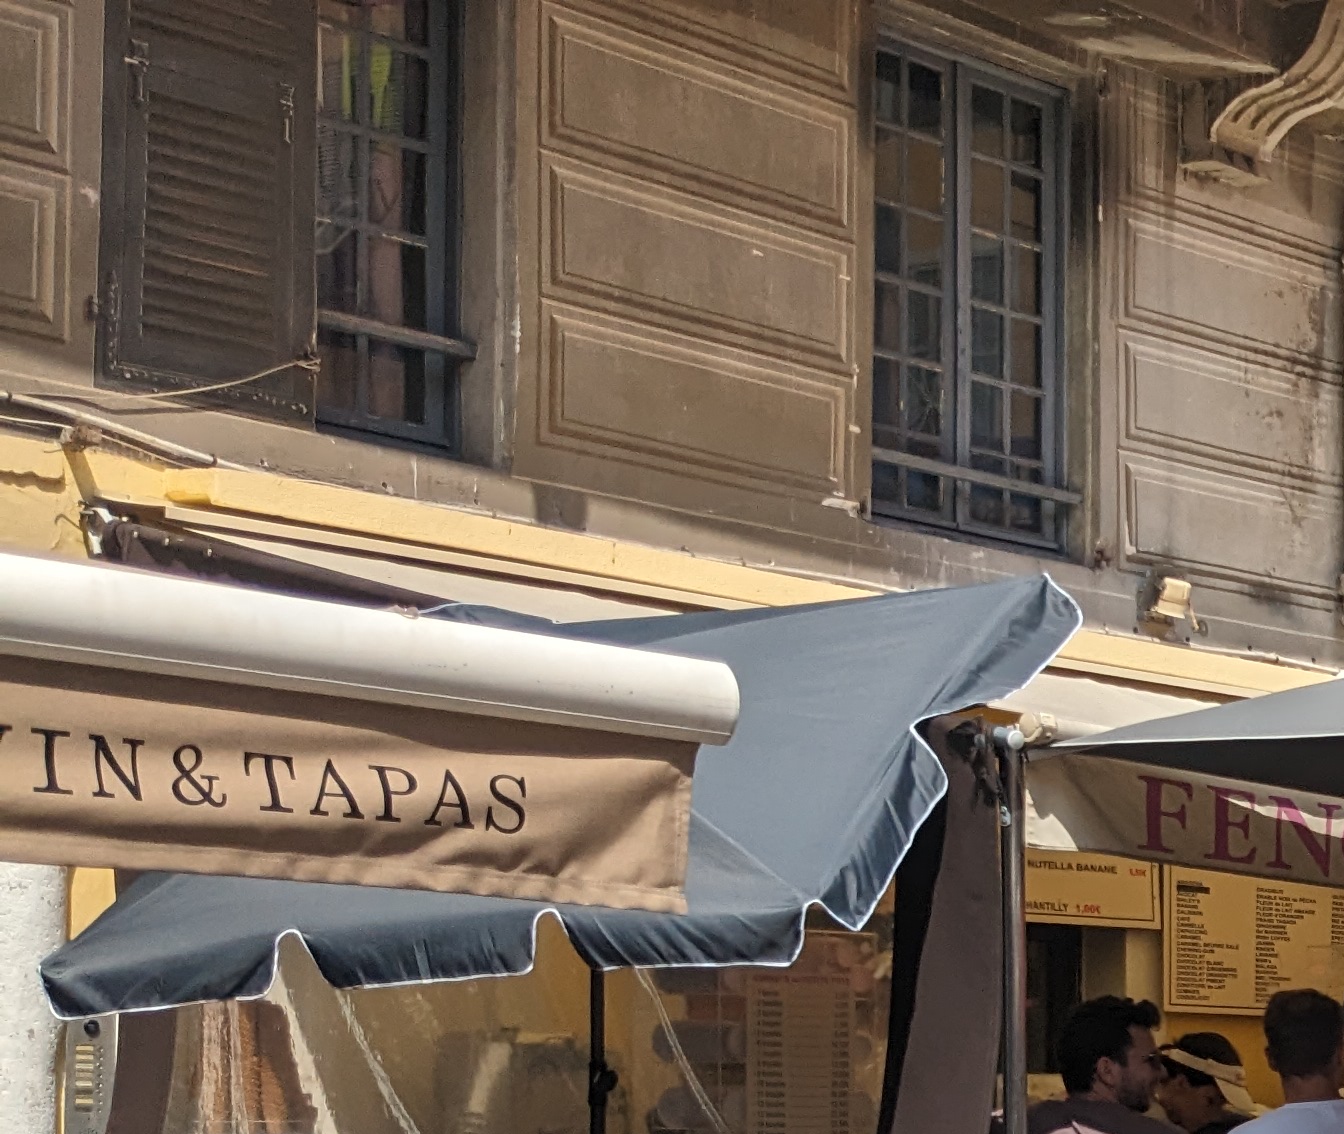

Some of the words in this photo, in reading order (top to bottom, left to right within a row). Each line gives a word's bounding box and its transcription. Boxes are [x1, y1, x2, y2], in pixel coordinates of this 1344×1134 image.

[1027, 859, 1074, 872] NUTELLA
[1076, 862, 1118, 875] BANANE
[1025, 901, 1068, 912] HANTILLY
